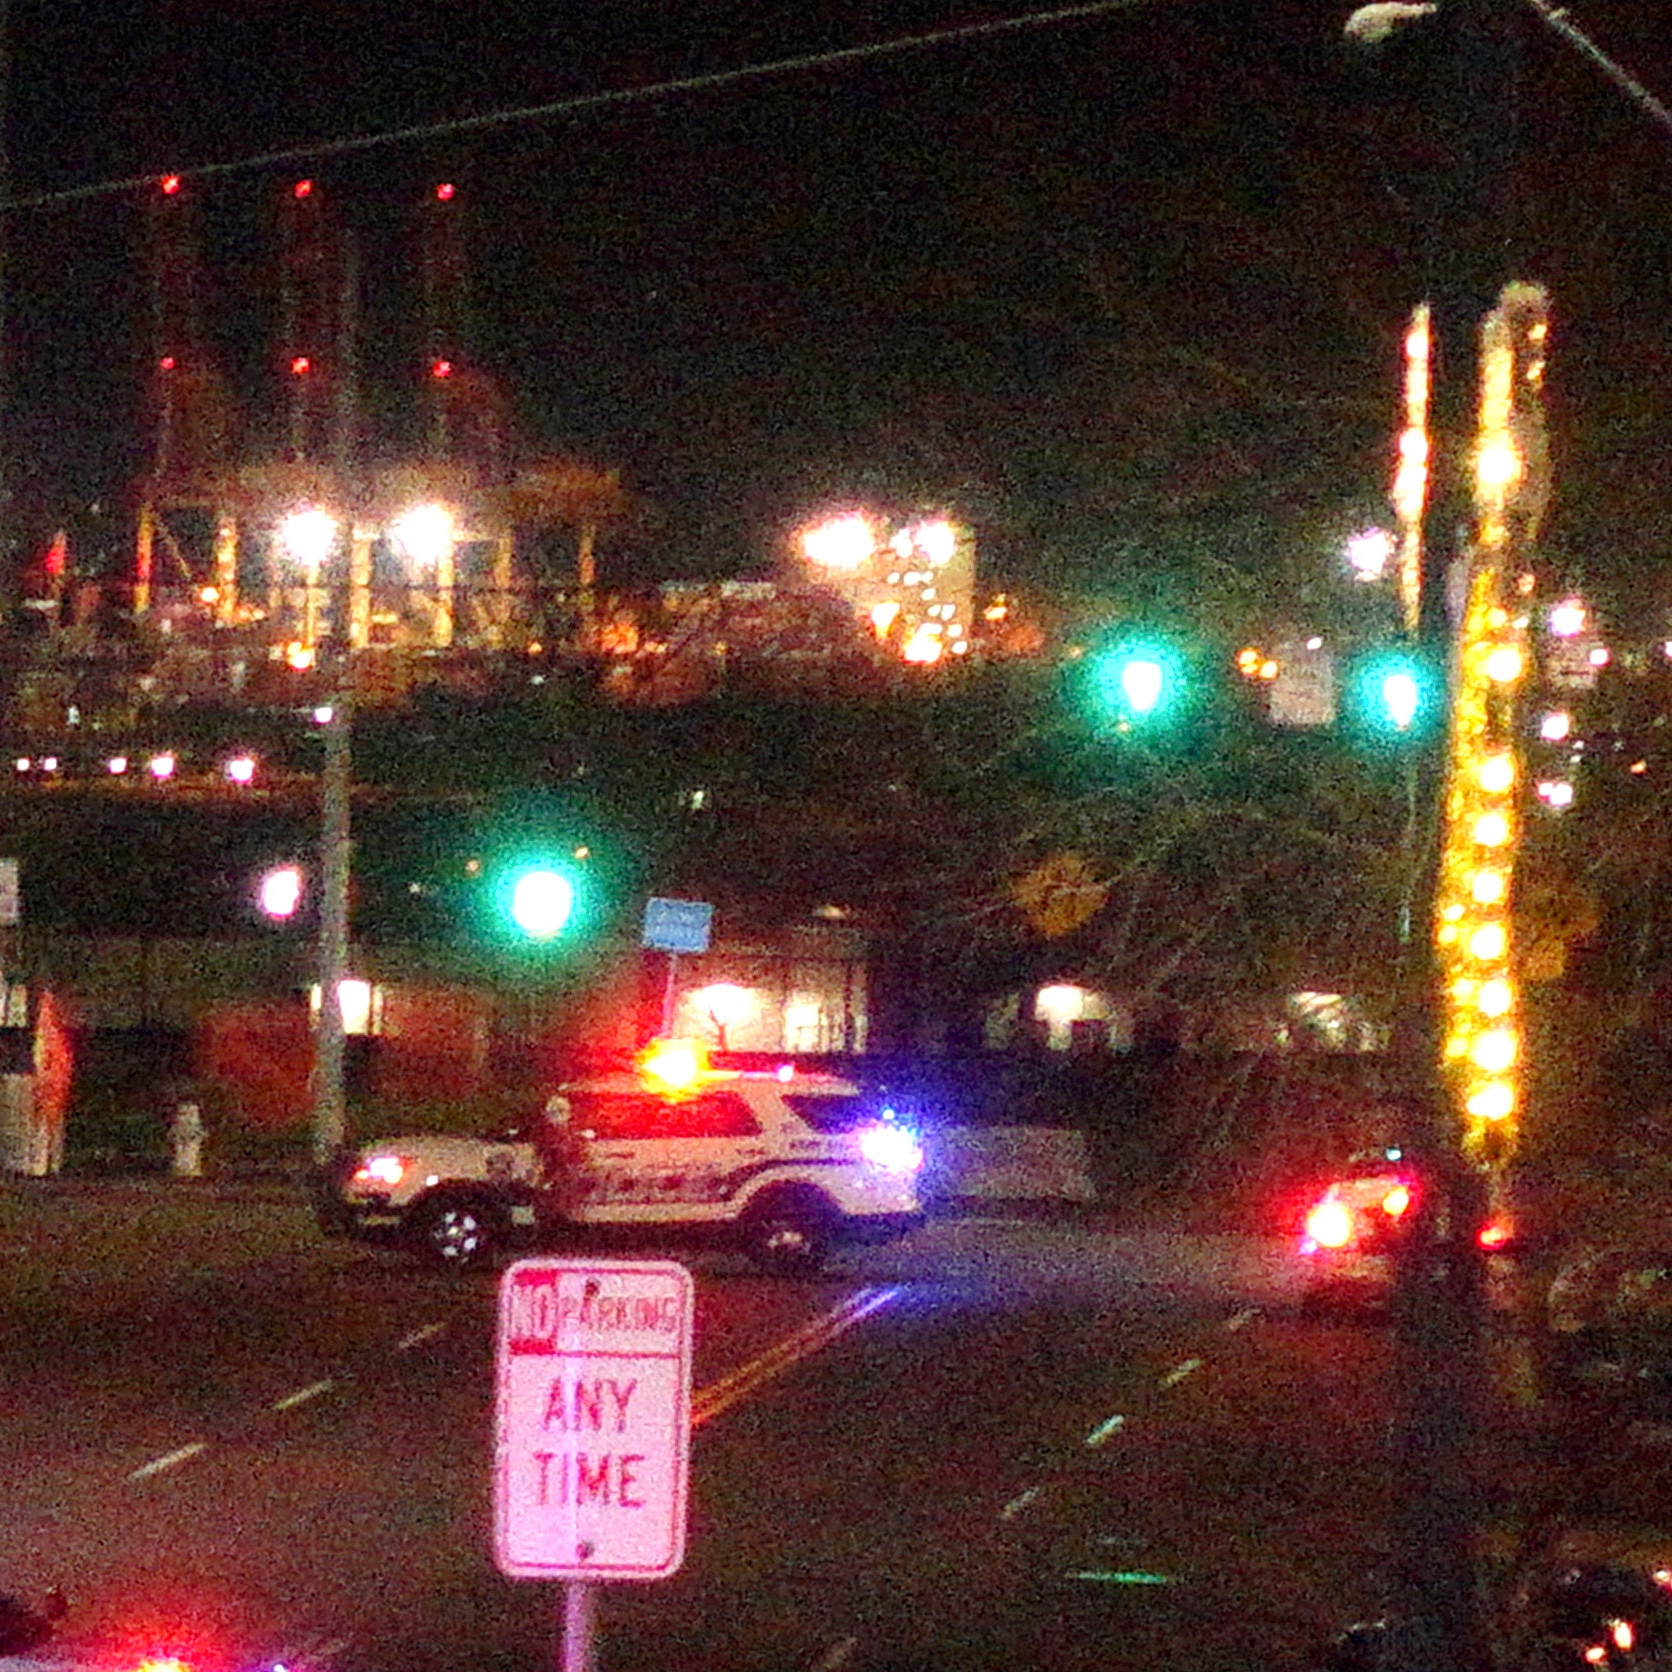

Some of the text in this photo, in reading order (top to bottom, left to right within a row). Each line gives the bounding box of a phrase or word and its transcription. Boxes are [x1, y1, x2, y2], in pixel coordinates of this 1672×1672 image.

[510, 1284, 677, 1339] NO PARKING
[542, 1376, 638, 1433] ANY
[533, 1452, 645, 1507] TIME
